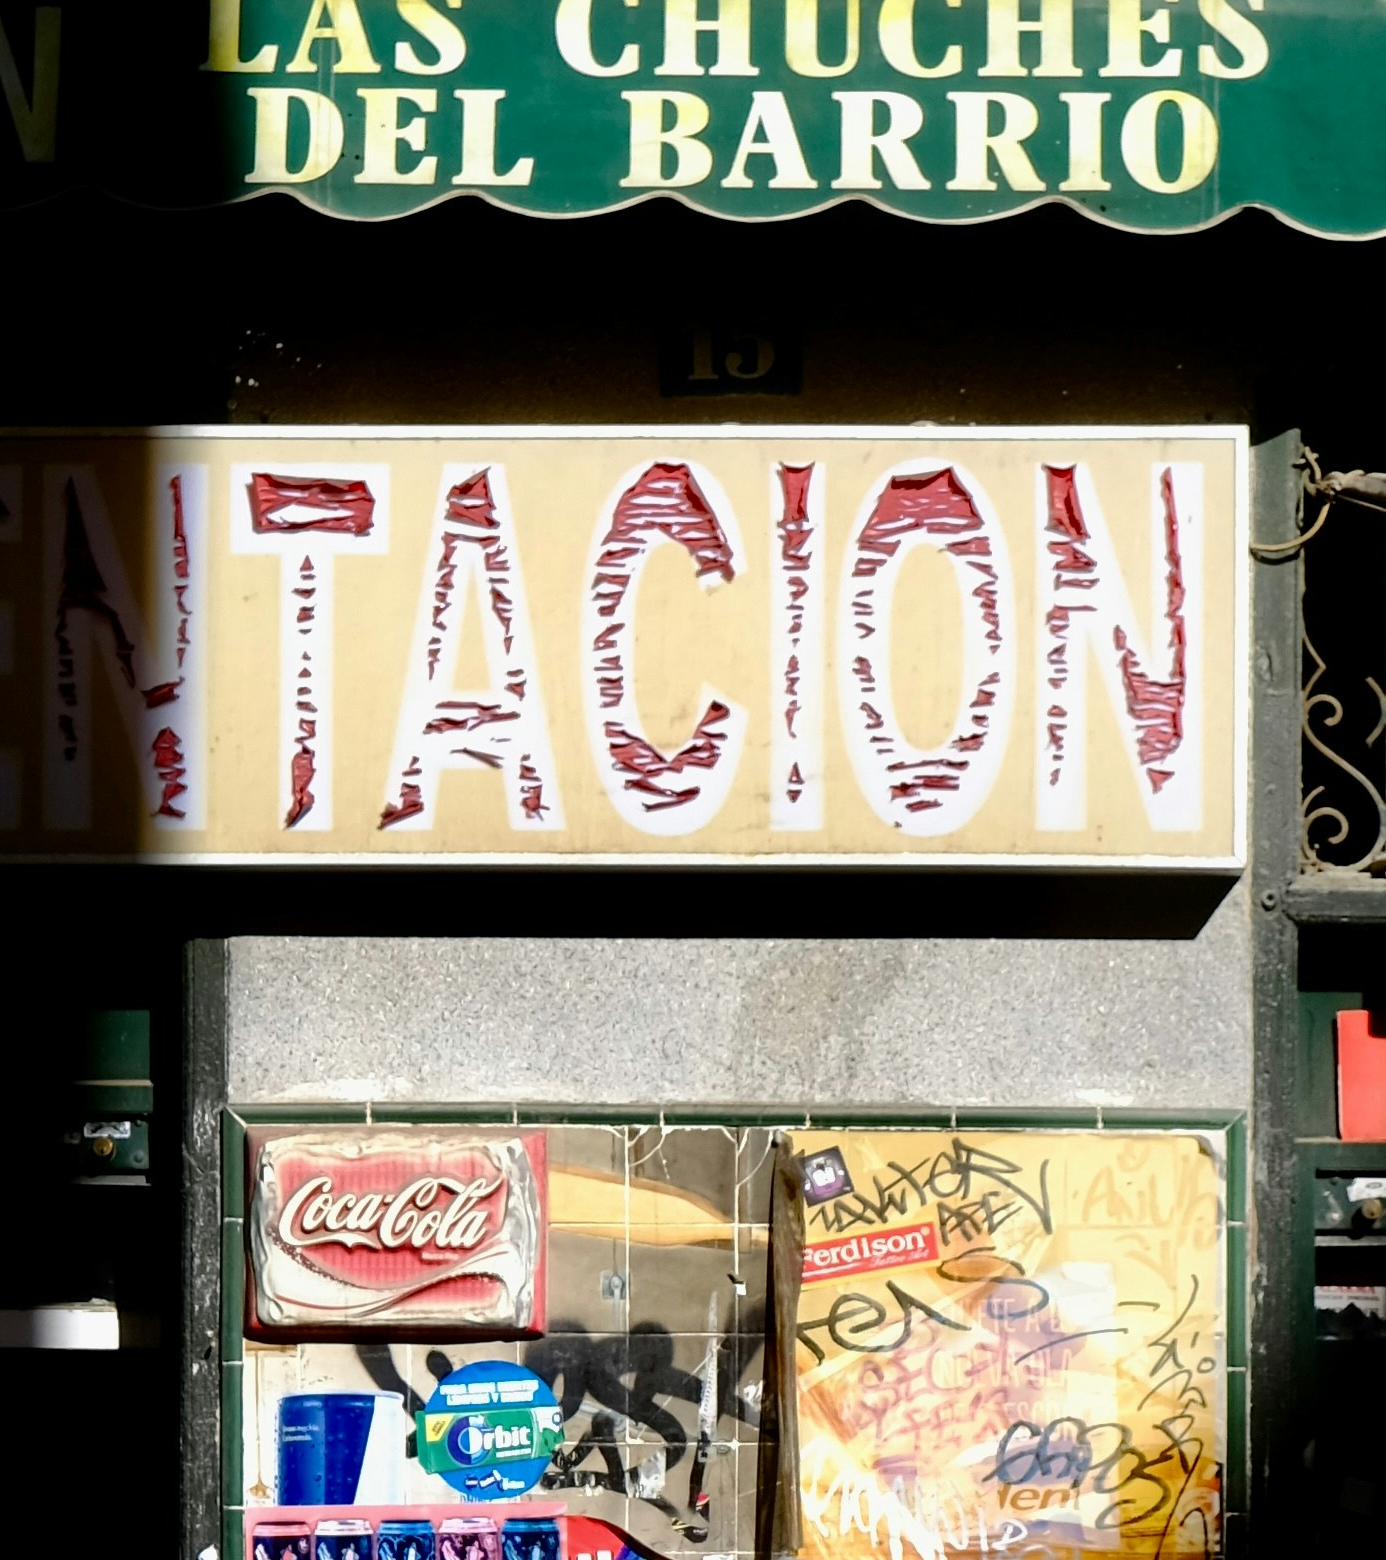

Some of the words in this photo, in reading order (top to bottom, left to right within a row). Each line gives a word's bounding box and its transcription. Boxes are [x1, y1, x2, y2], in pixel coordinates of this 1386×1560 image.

[245, 88, 534, 187] DEL
[619, 90, 1218, 194] BARRIO
[278, 1176, 503, 1251] Coca-Cola
[458, 1425, 531, 1454] Orbit
